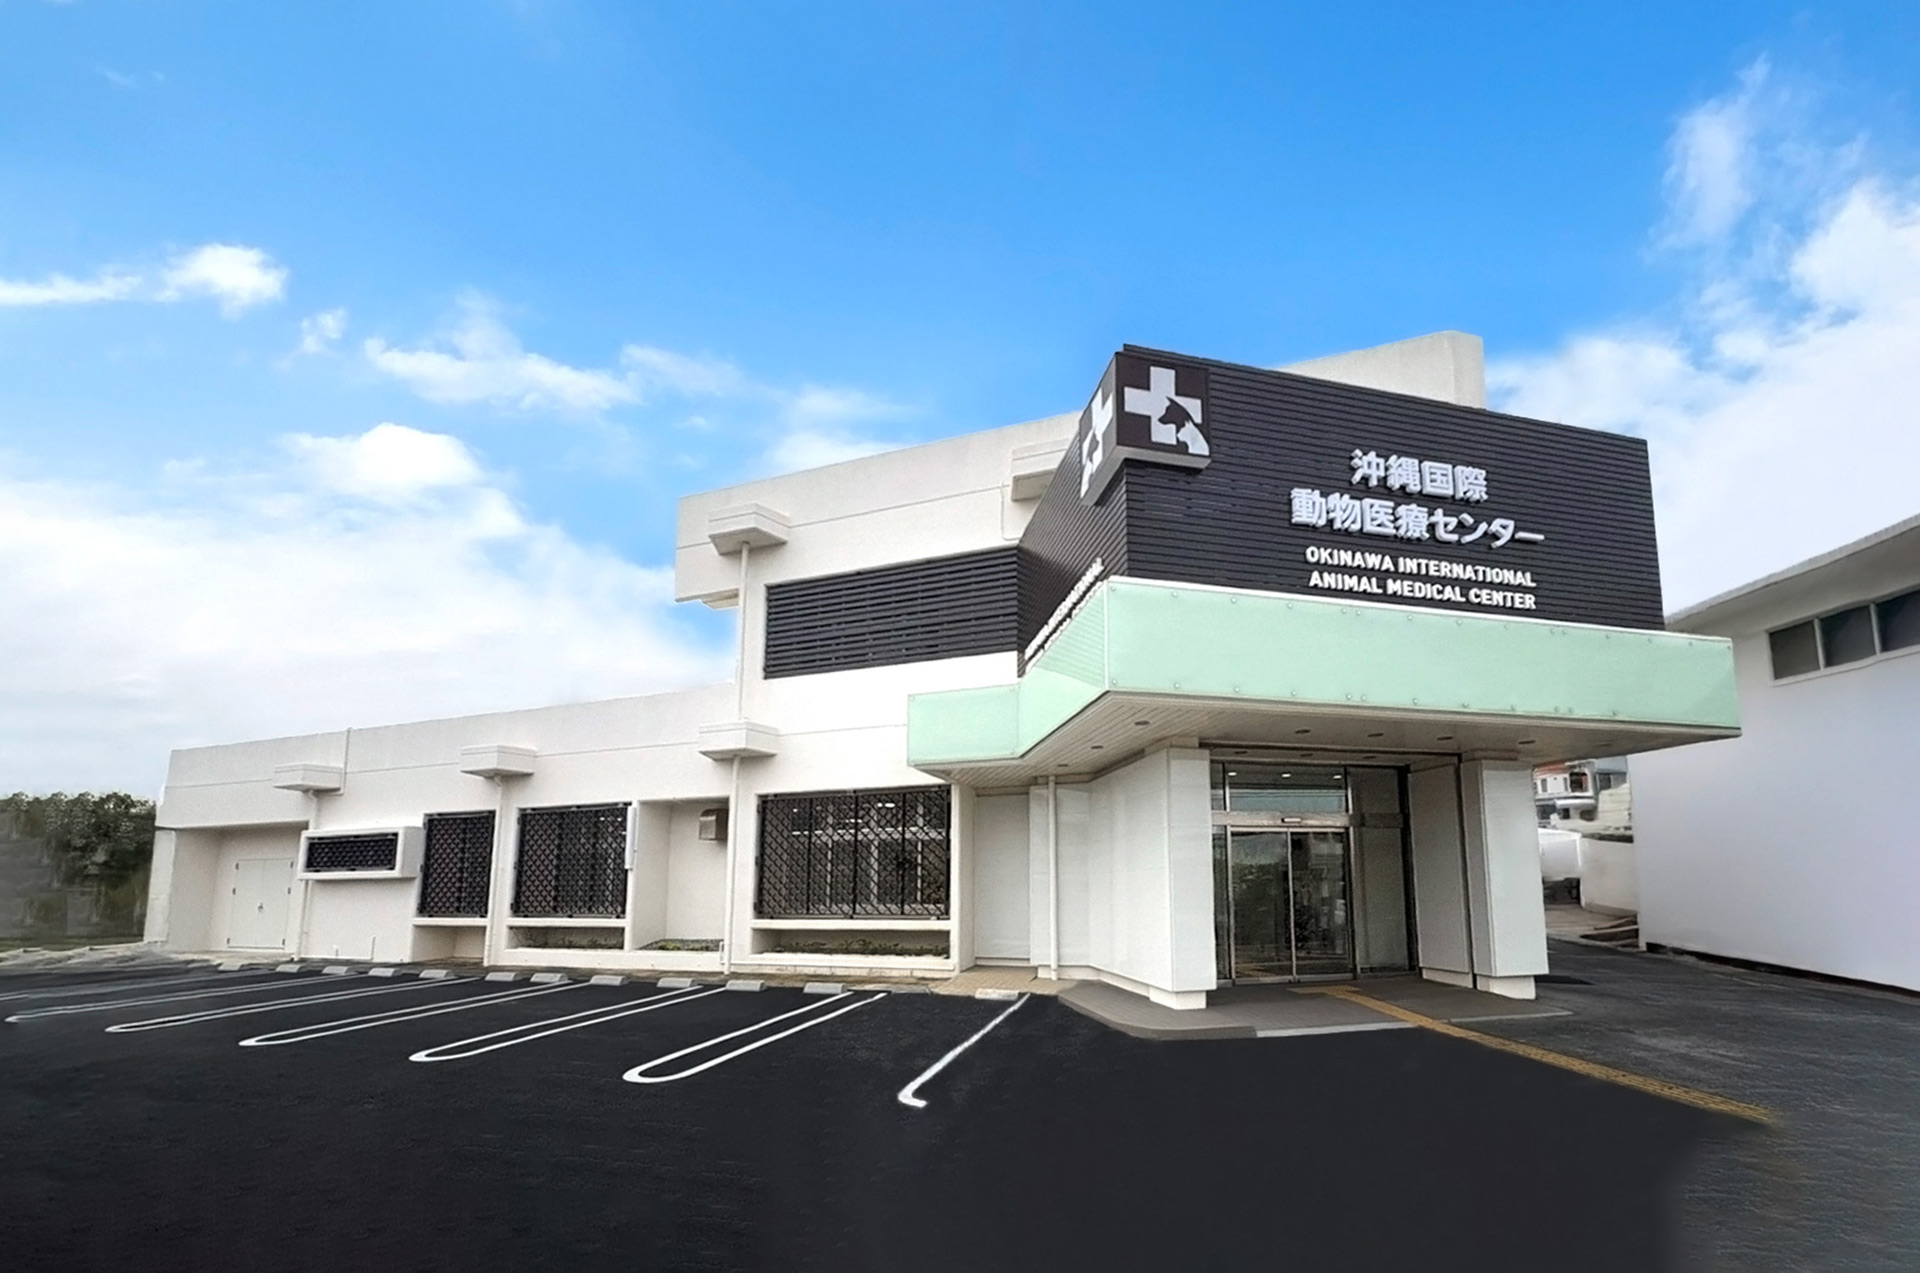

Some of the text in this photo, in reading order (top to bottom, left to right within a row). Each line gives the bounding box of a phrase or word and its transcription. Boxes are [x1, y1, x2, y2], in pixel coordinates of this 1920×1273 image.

[1350, 449, 1488, 501] 沖縄国際
[1290, 488, 1545, 549] 動物医療センター
[1305, 546, 1537, 587] OKINAWA INTERNATIONAL
[1308, 570, 1537, 610] ANIMAL MEDICAL CENTER
